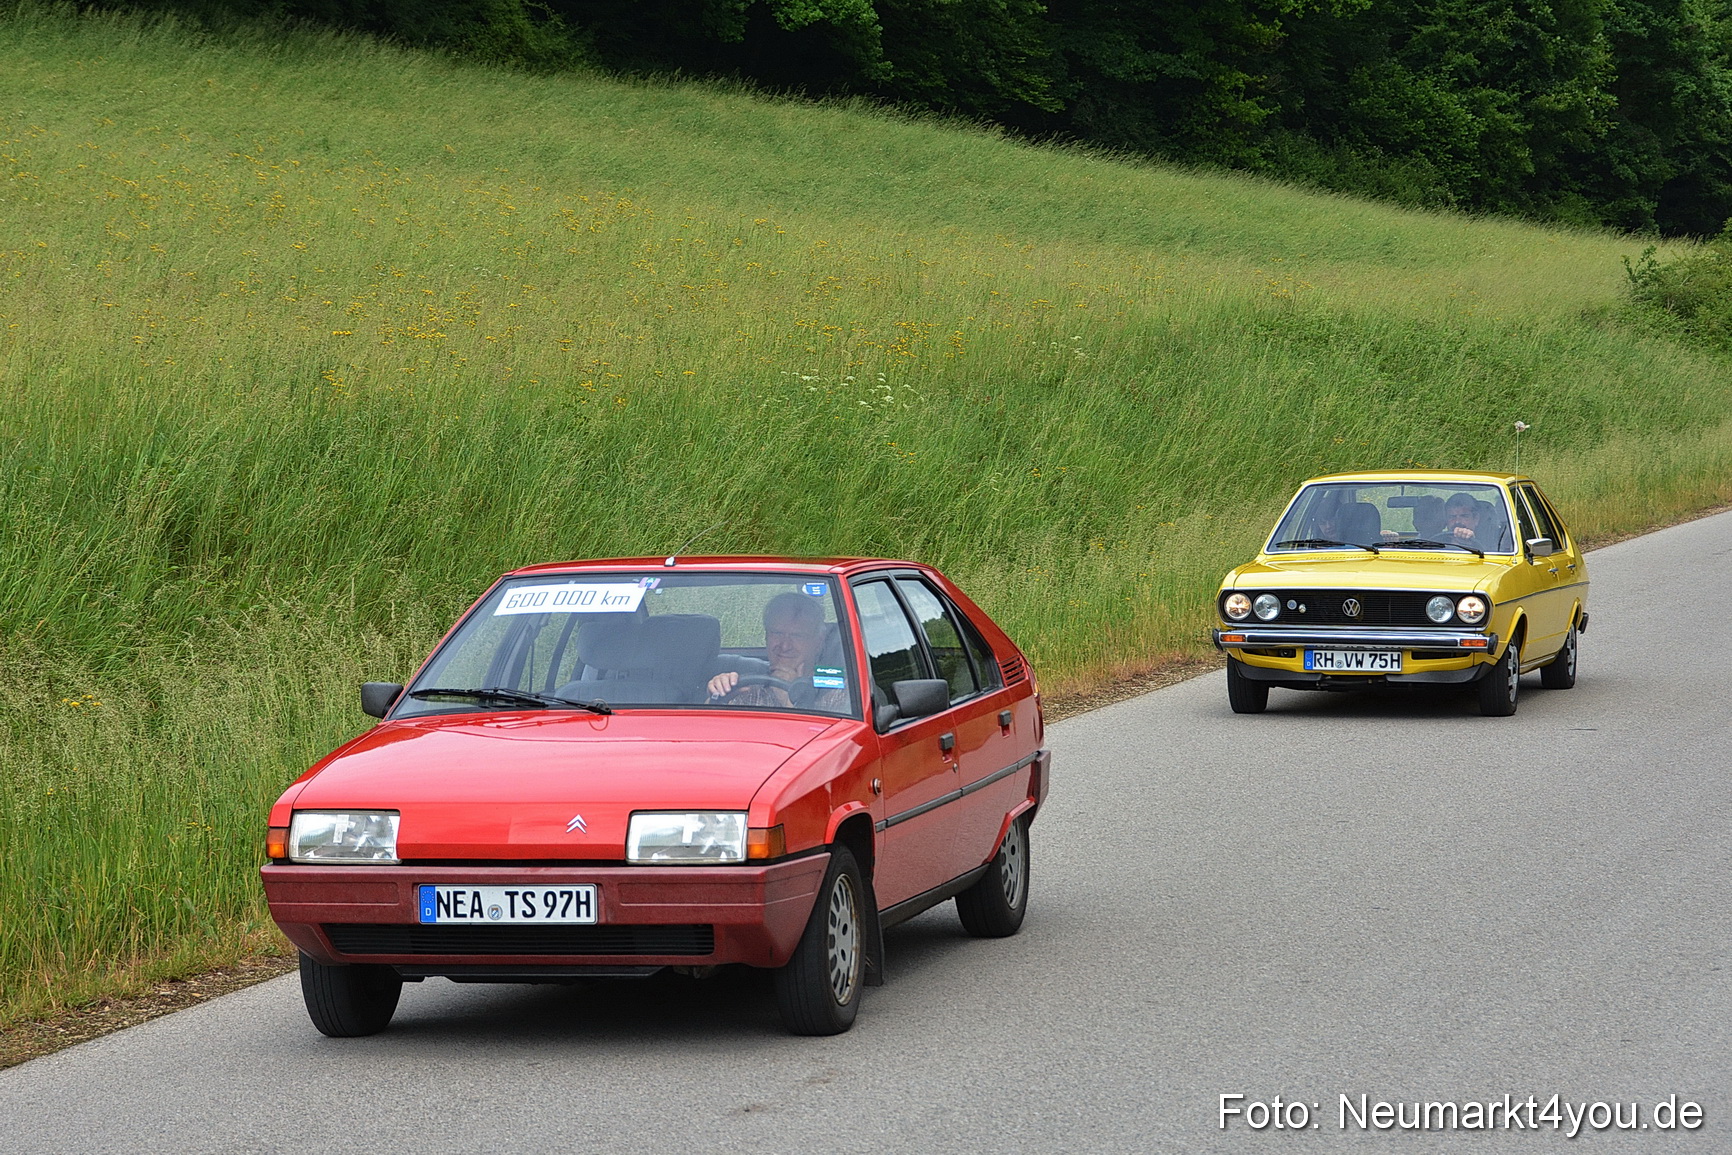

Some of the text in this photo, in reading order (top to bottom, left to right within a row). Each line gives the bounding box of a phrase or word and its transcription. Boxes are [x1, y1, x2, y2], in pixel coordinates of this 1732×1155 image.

[506, 590, 631, 609] 600 000 km
[1313, 652, 1401, 669] RH VW 75H
[425, 907, 432, 917] D
[436, 890, 592, 919] NEA TS 97H
